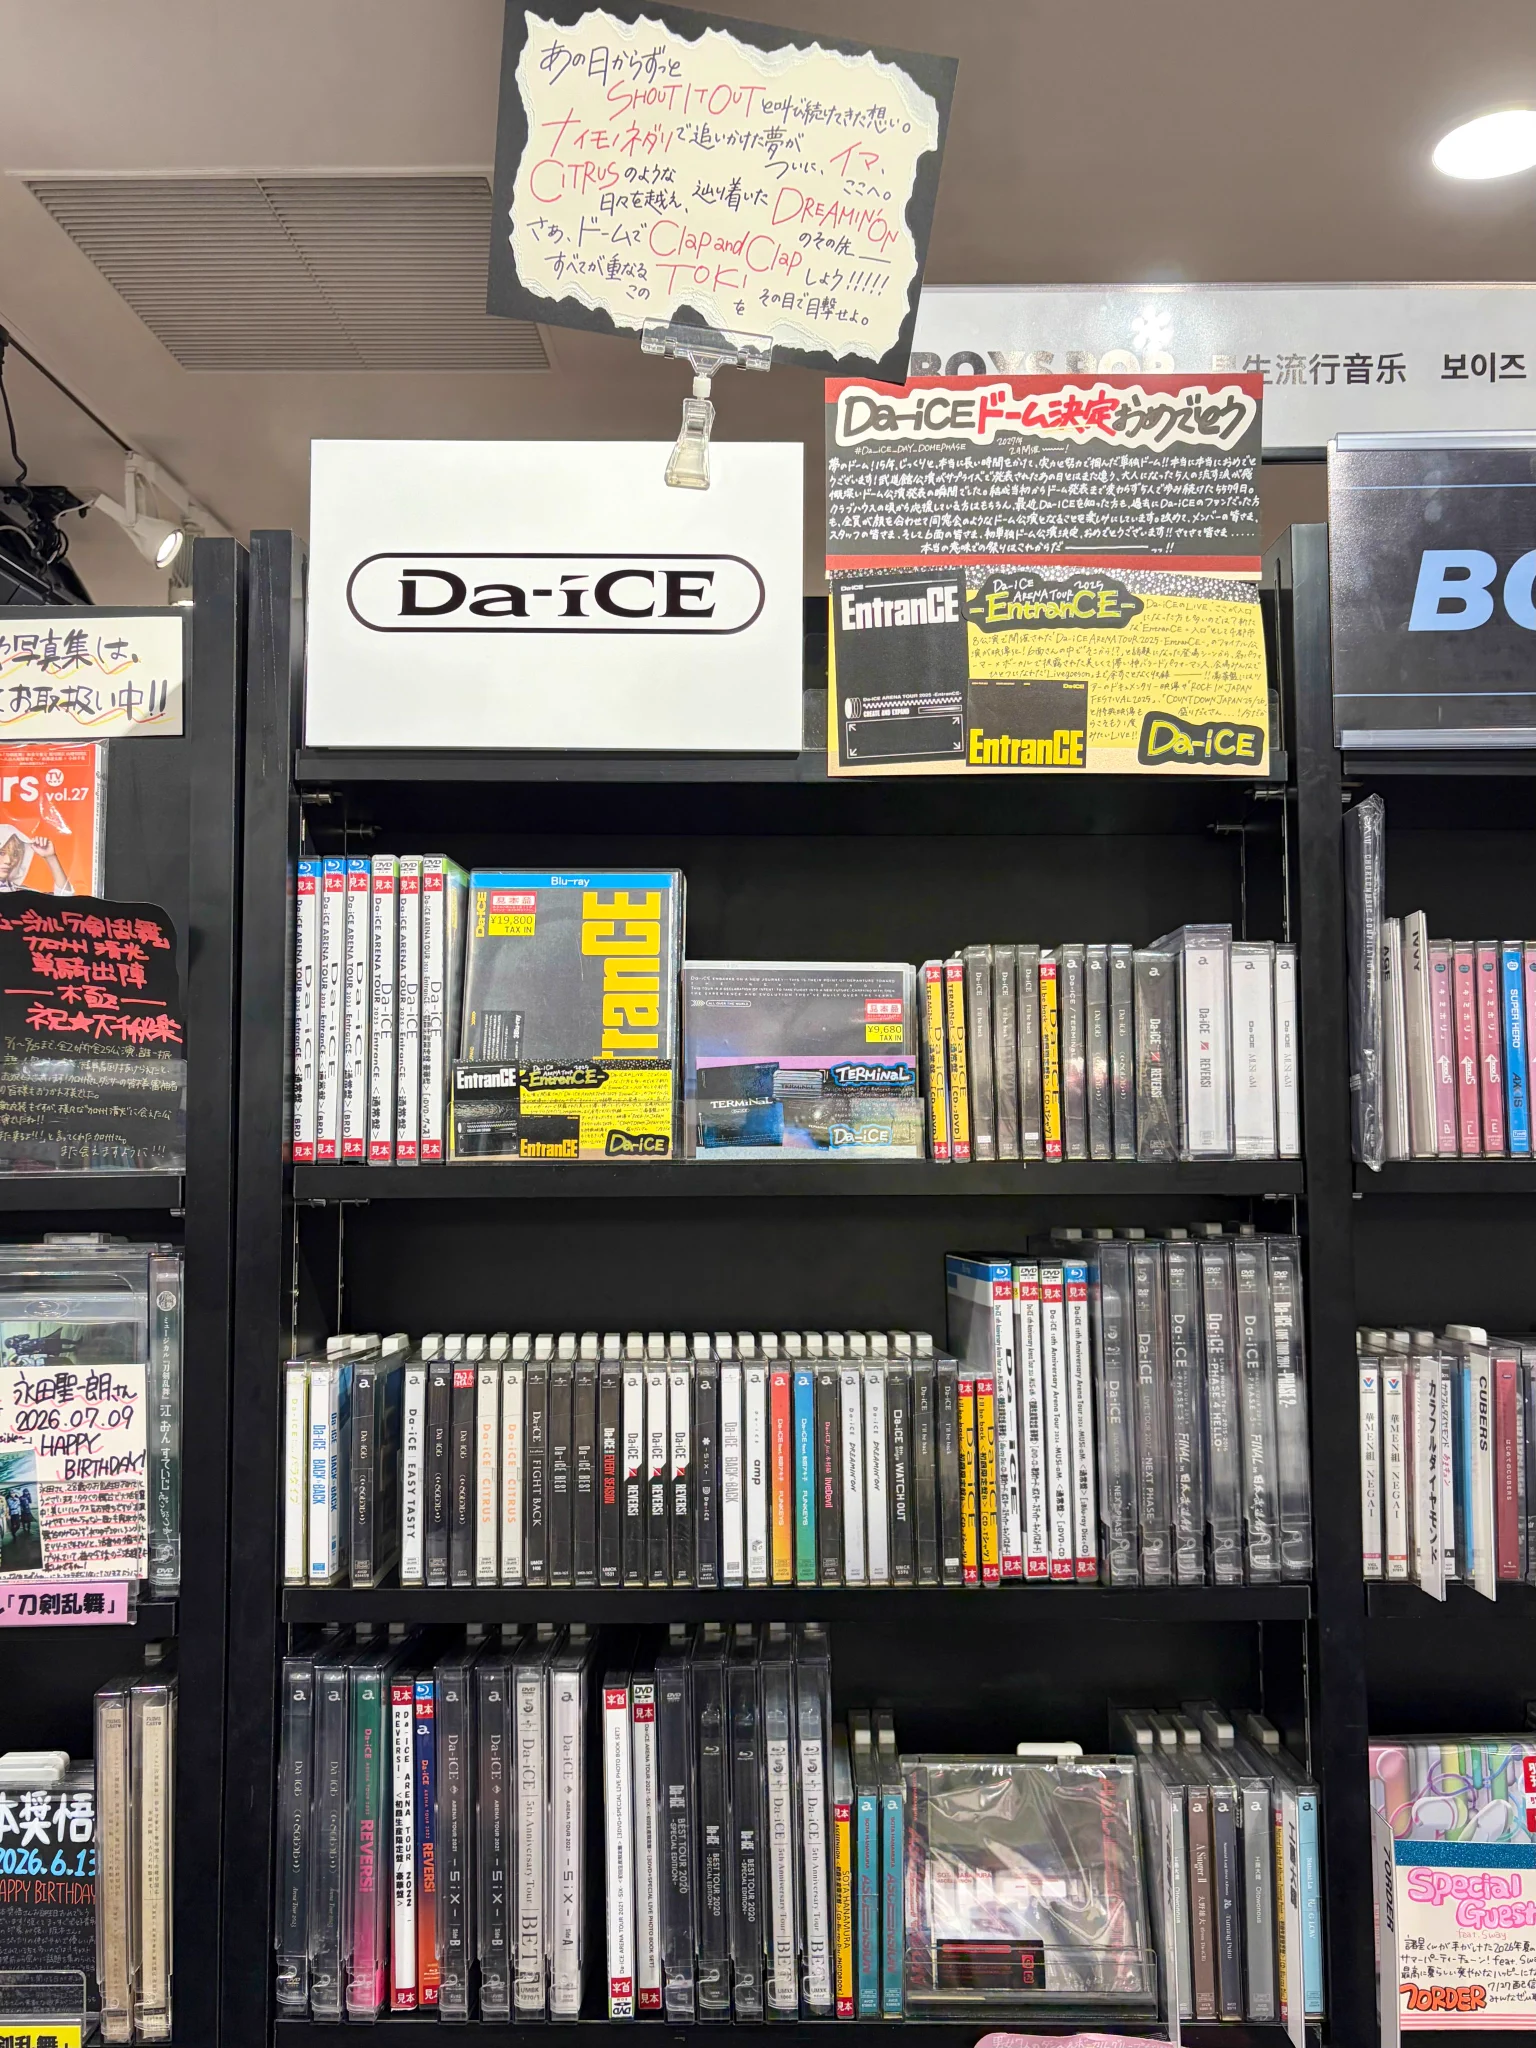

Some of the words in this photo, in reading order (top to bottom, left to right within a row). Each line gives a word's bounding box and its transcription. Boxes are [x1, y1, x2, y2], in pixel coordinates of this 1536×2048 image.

[1441, 353, 1528, 384] 보이즈
[397, 568, 717, 618] Da-iCE
[840, 585, 959, 631] EntranCE
[969, 729, 1085, 766] EntranCE
[1147, 720, 1255, 757] Da-iCE
[46, 788, 89, 801] vol.27
[375, 878, 393, 892] 見本
[401, 878, 418, 892] 見本
[425, 876, 442, 889] 見本
[550, 876, 590, 886] Blu-ray
[490, 915, 533, 925] ¥19,800
[374, 934, 382, 970] ARENA
[373, 973, 382, 1003] TOUR
[399, 973, 407, 1003] TOUR
[1510, 989, 1519, 1019] SUPER
[867, 1025, 902, 1033] ¥9,680
[1511, 1021, 1520, 1048] HERO
[457, 1067, 517, 1089] EntranCE
[1200, 1058, 1212, 1088] REVERSi
[520, 1139, 578, 1158] EntranCE
[994, 1286, 1011, 1298] 見本
[1021, 1286, 1038, 1298] 見本
[1044, 1287, 1061, 1300] 見本
[1069, 1286, 1086, 1298] 見本
[1050, 1347, 1060, 1389] Anniversary
[1074, 1338, 1083, 1379] Anniversary
[1051, 1391, 1060, 1412] Arena
[1479, 1375, 1488, 1451] CUBERS
[15, 1408, 134, 1432] 2026.07.09
[408, 1408, 418, 1451] Da-iCE
[1053, 1414, 1061, 1429] Tour
[40, 1432, 101, 1457] HAPPY
[1178, 1433, 1190, 1464] FINAL
[1251, 1434, 1264, 1464] FINAL
[64, 1448, 146, 1480] BIRTHDAY!
[312, 1459, 326, 1480] BACK
[407, 1463, 417, 1495] EASY
[532, 1460, 541, 1494] FIGHT
[604, 1454, 615, 1475] EVERY
[751, 1459, 761, 1485] amp
[1428, 1380, 1440, 1565] カラフルダイヤモンド
[312, 1484, 326, 1505] BACK
[554, 1475, 566, 1492] BEST
[578, 1475, 590, 1492] BEST
[604, 1477, 615, 1504] SEASON
[825, 1477, 834, 1508] liveDevil
[895, 1462, 905, 1500] WATCH
[1366, 1470, 1375, 1517] NEGAI
[1392, 1471, 1401, 1518] NEGAI
[508, 1478, 516, 1523] CITRUS
[532, 1497, 541, 1527] BACK
[627, 1484, 639, 1516] REVERSi
[896, 1502, 906, 1522] OUT
[406, 1500, 416, 1540] TASTY
[0, 1593, 115, 1615] 「刀剣乱舞」
[393, 1690, 411, 1703] 見本
[416, 1703, 433, 1716] 見本
[522, 1738, 535, 1790] Da-iCE
[524, 1801, 535, 1814] 5th
[678, 1818, 687, 1838] BEST
[360, 1819, 374, 1892] REVERSi
[523, 1818, 535, 1878] Anniversary
[679, 1840, 688, 1867] TOUR
[422, 1842, 435, 1892] REVERSi
[679, 1870, 688, 1894] 2020
[842, 1870, 851, 1893] SOTA
[525, 1882, 535, 1903] Tour
[777, 1859, 788, 1907] Anniversary
[811, 1859, 820, 1907] Anniversary
[1383, 1845, 1394, 1934] 7ORDER
[1408, 1867, 1522, 1906] Special
[780, 1910, 789, 1932] Tour
[813, 1910, 821, 1932] Tour
[842, 1896, 852, 1949] HANAMURA
[521, 1915, 538, 1965] BET
[1400, 1982, 1487, 2012] 7ORDER
